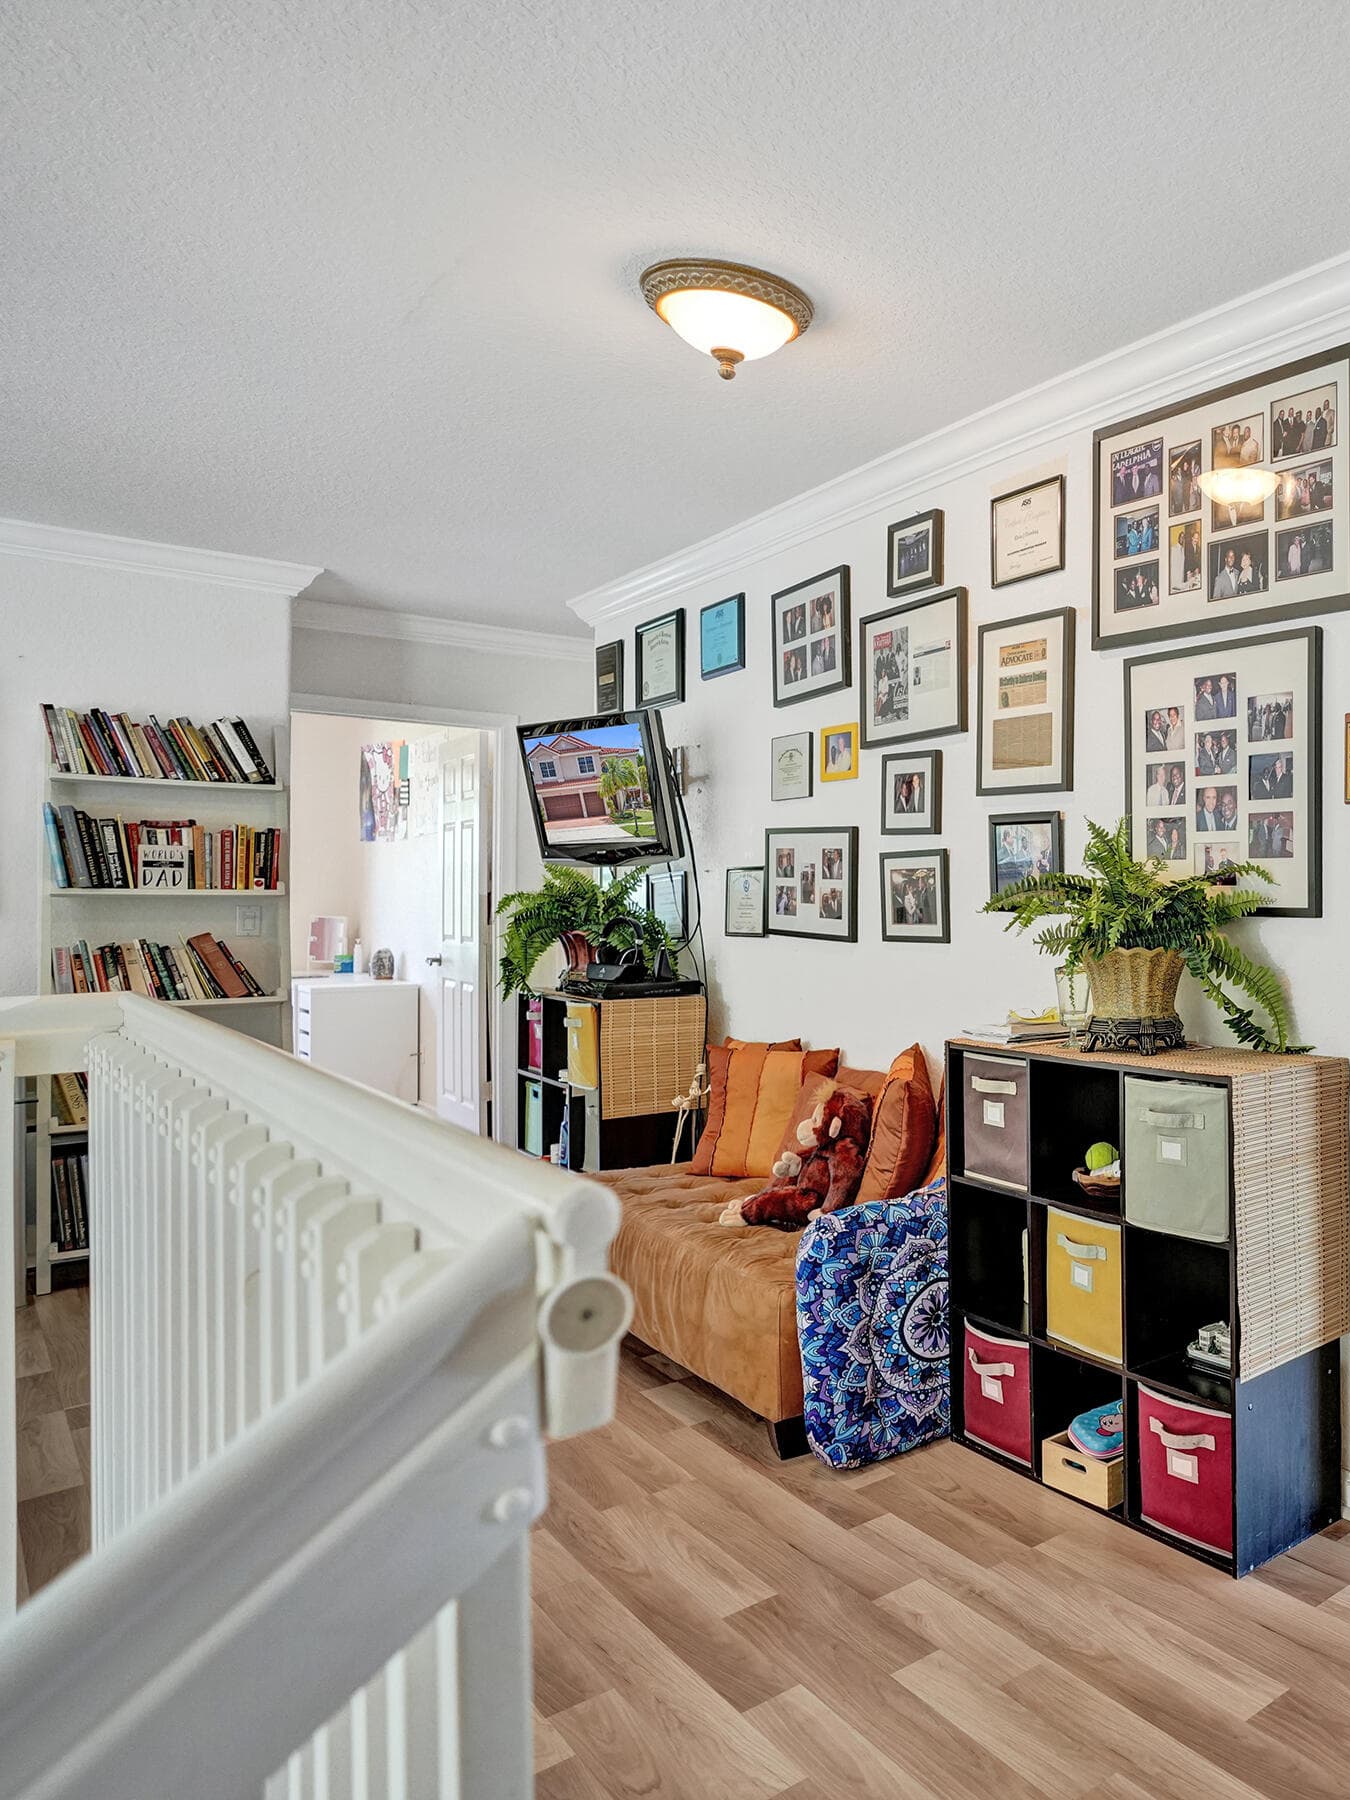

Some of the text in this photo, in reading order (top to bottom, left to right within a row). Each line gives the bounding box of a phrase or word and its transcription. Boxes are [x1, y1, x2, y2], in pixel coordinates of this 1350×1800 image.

[1001, 652, 1033, 667] ADVOCATE
[144, 849, 184, 860] WORLD'S
[143, 869, 182, 887] DAD
